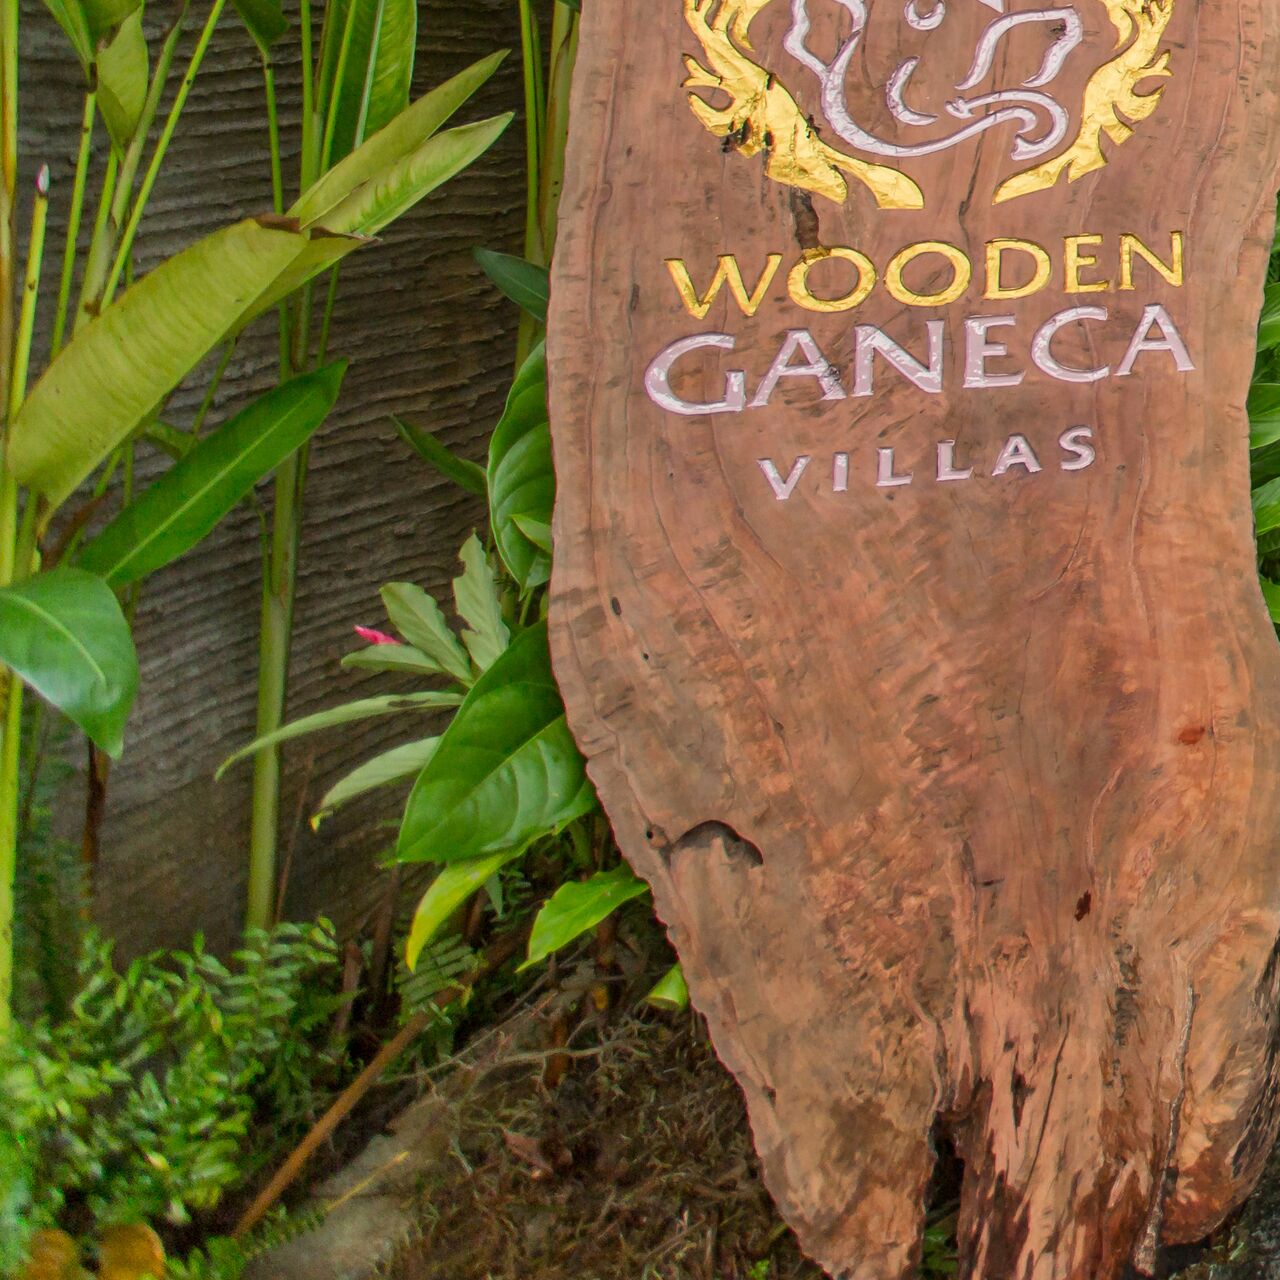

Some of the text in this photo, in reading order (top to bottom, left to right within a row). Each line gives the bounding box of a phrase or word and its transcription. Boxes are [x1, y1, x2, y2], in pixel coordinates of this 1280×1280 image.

[663, 231, 1187, 320] WOODEN
[643, 303, 1196, 417] GANECA
[757, 425, 1097, 501] VILLAS
